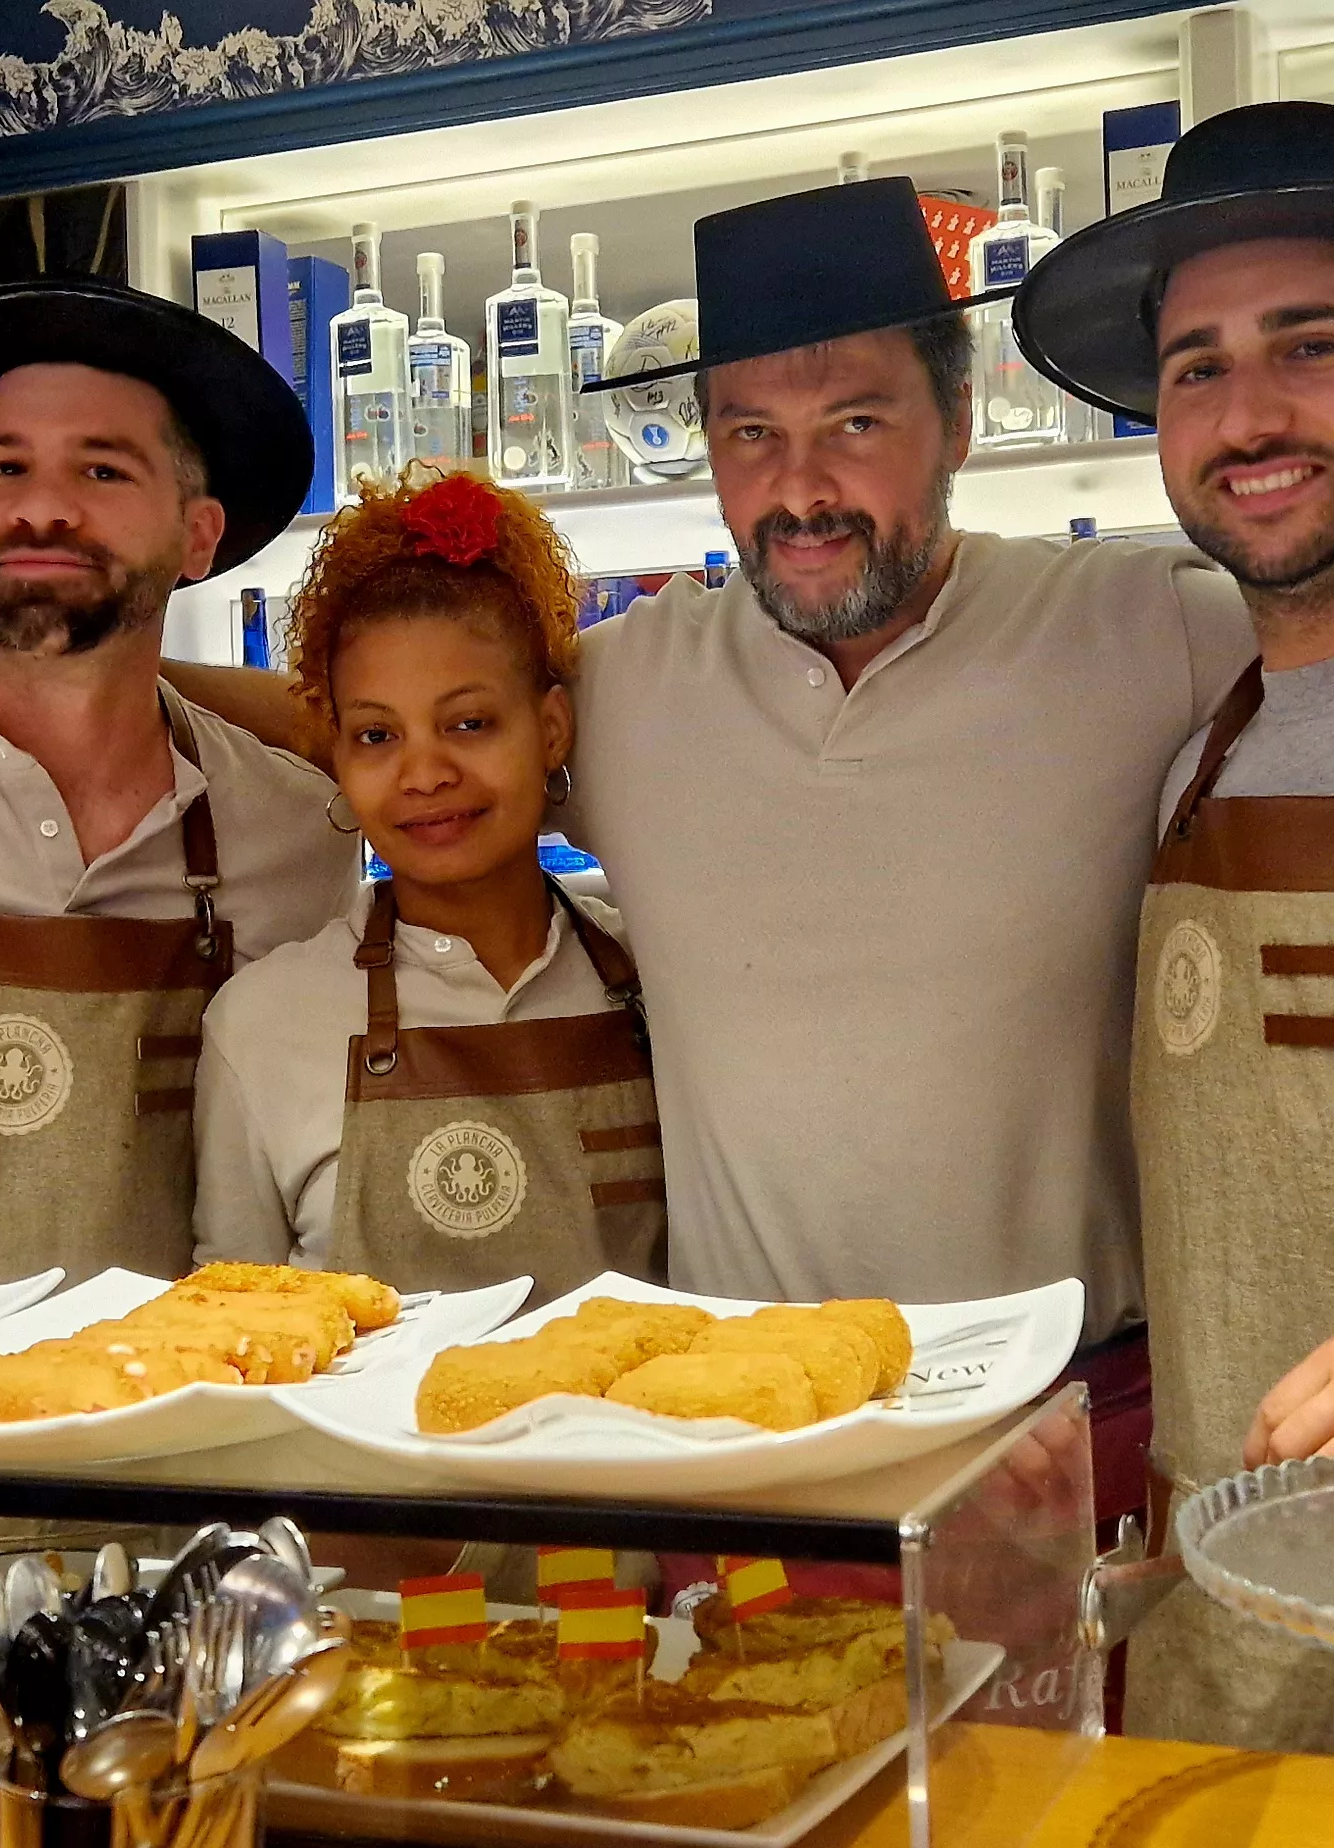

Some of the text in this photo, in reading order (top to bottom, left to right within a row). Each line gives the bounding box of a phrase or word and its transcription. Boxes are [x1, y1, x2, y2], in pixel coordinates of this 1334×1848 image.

[202, 293, 252, 305] MACALLAN
[221, 316, 236, 329] 12
[429, 1131, 504, 1159] LA PLANCHA
[902, 1360, 995, 1385] New
